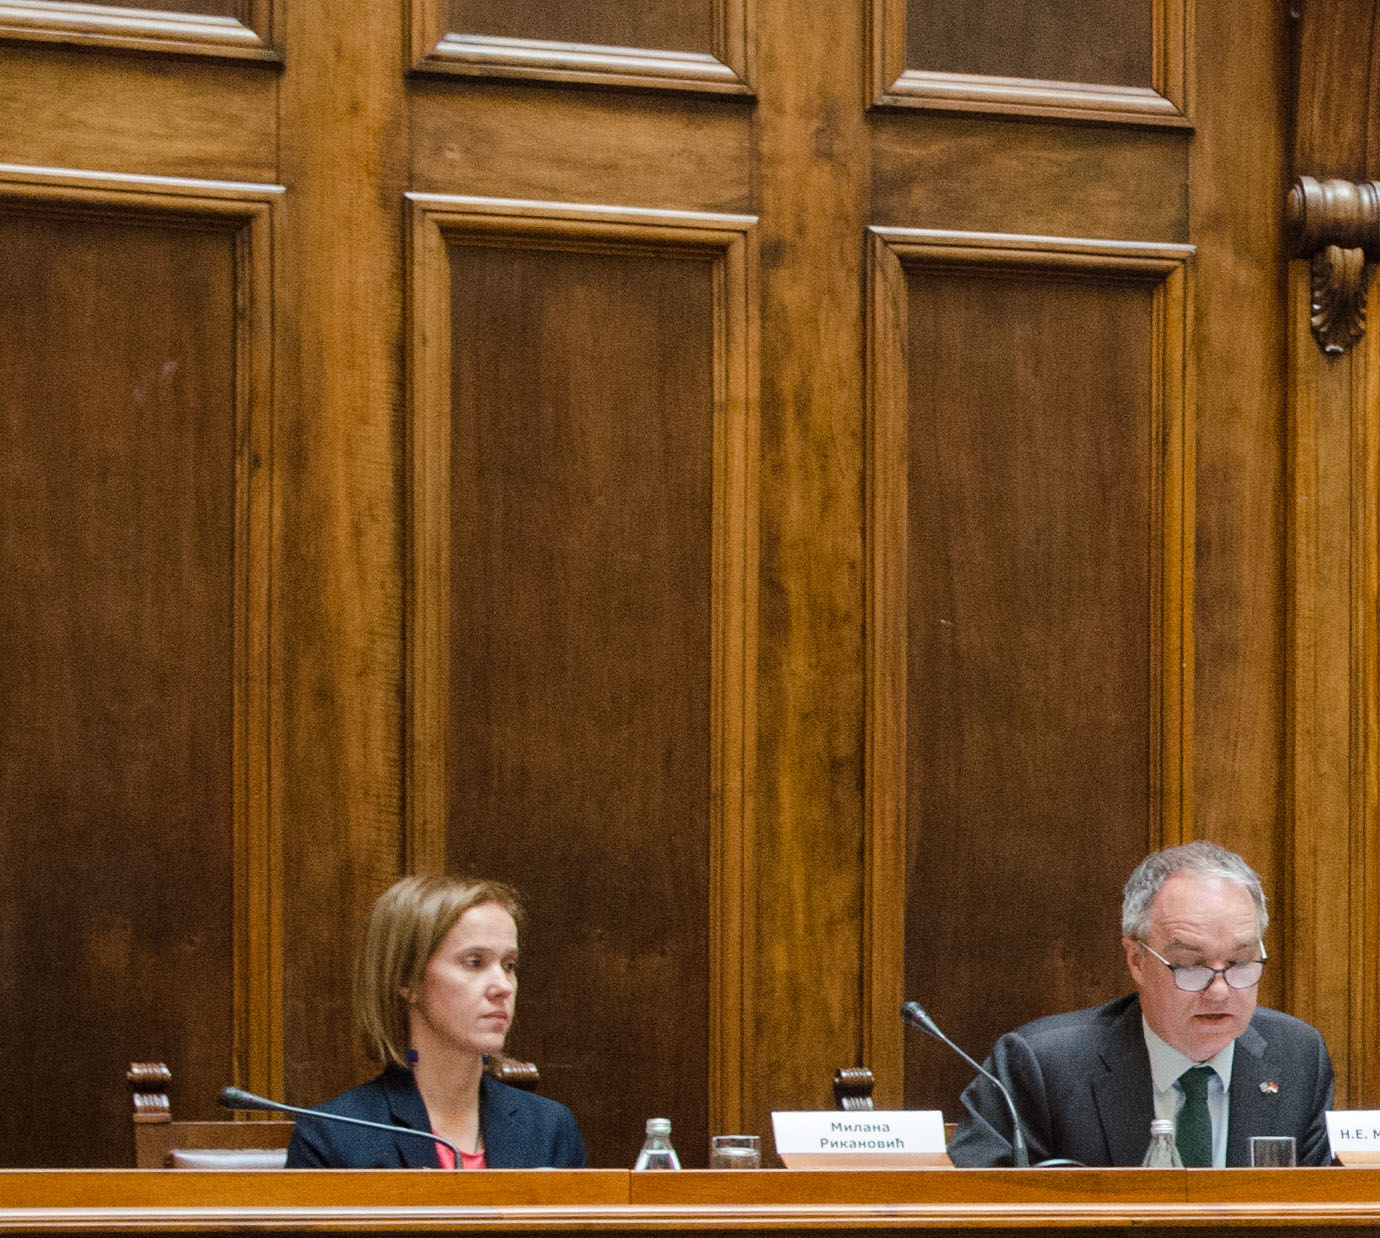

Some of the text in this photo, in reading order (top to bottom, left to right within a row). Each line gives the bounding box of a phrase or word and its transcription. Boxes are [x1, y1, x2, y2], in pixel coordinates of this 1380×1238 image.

[830, 1122, 891, 1133] Милана
[1340, 1128, 1368, 1140] H.E.
[819, 1137, 905, 1149] Рикановић
